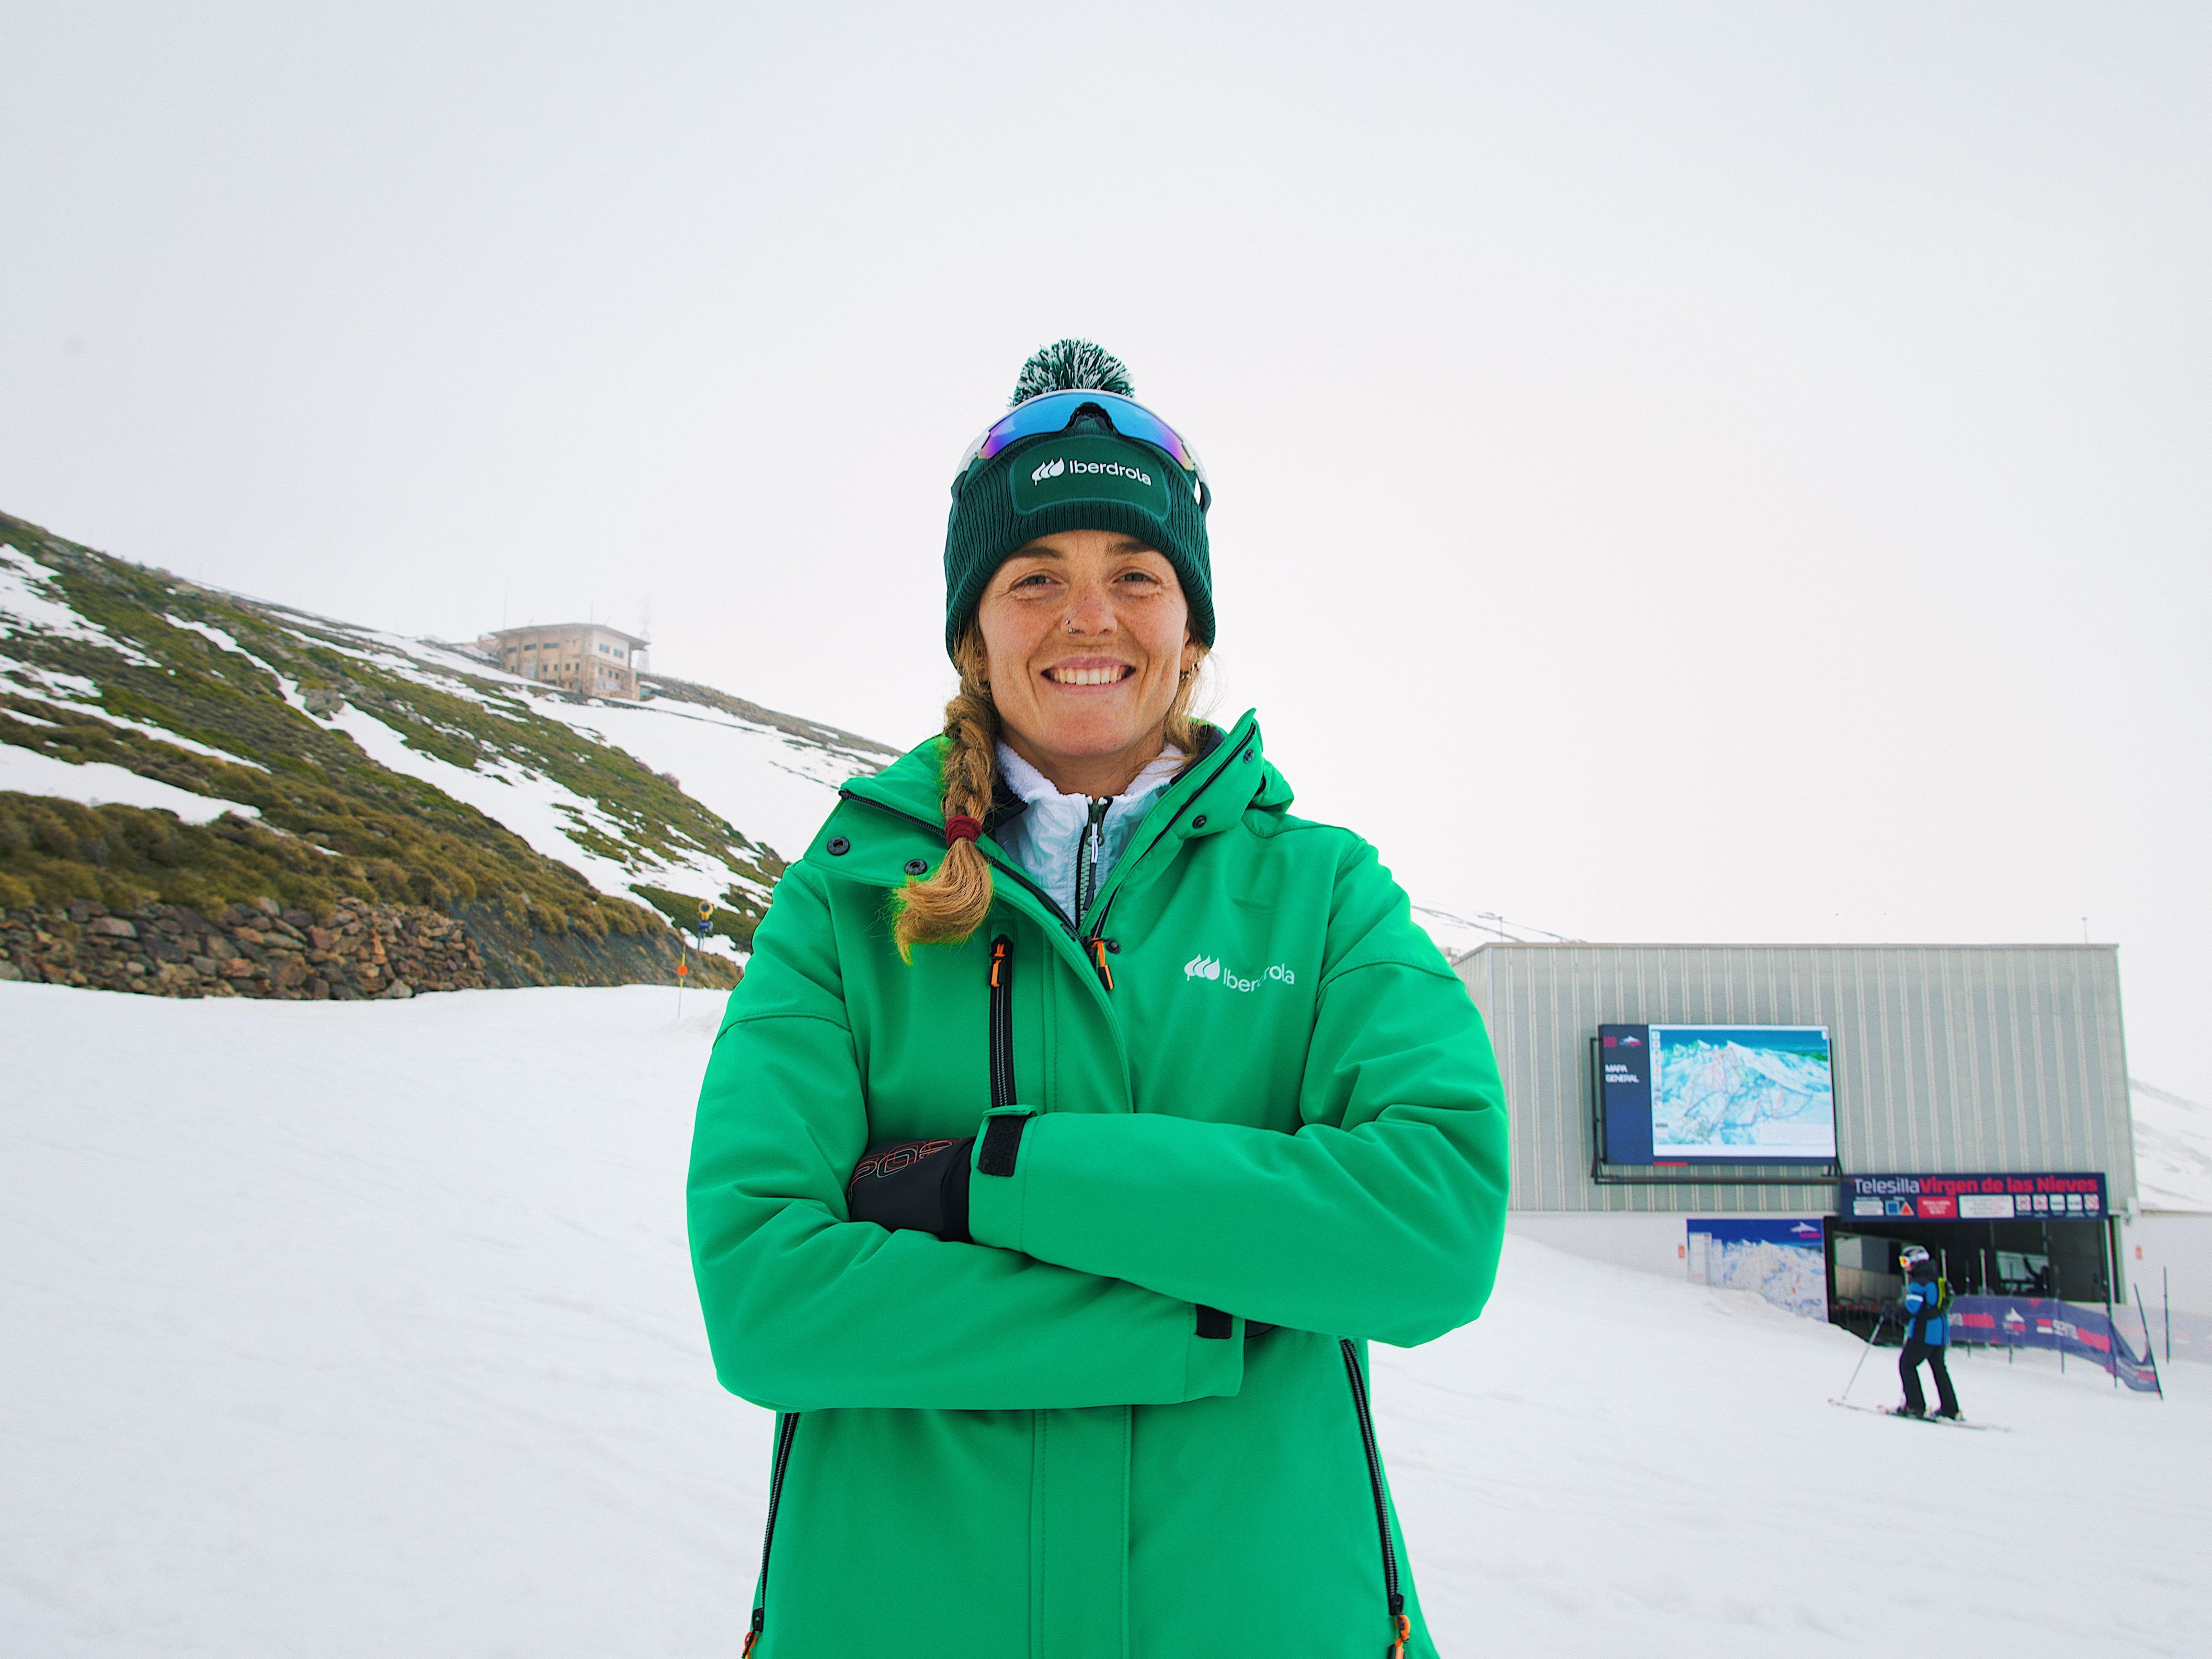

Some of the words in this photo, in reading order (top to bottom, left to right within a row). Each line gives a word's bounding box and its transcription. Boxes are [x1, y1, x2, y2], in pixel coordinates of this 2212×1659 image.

[1069, 460, 1151, 486] Iberdrola
[1854, 1177, 1920, 1194] Telesilla
[1919, 1176, 1978, 1196] Virgen
[1981, 1176, 2004, 1193] de
[2007, 1175, 2034, 1193] las
[2037, 1175, 2098, 1192] Nieves
